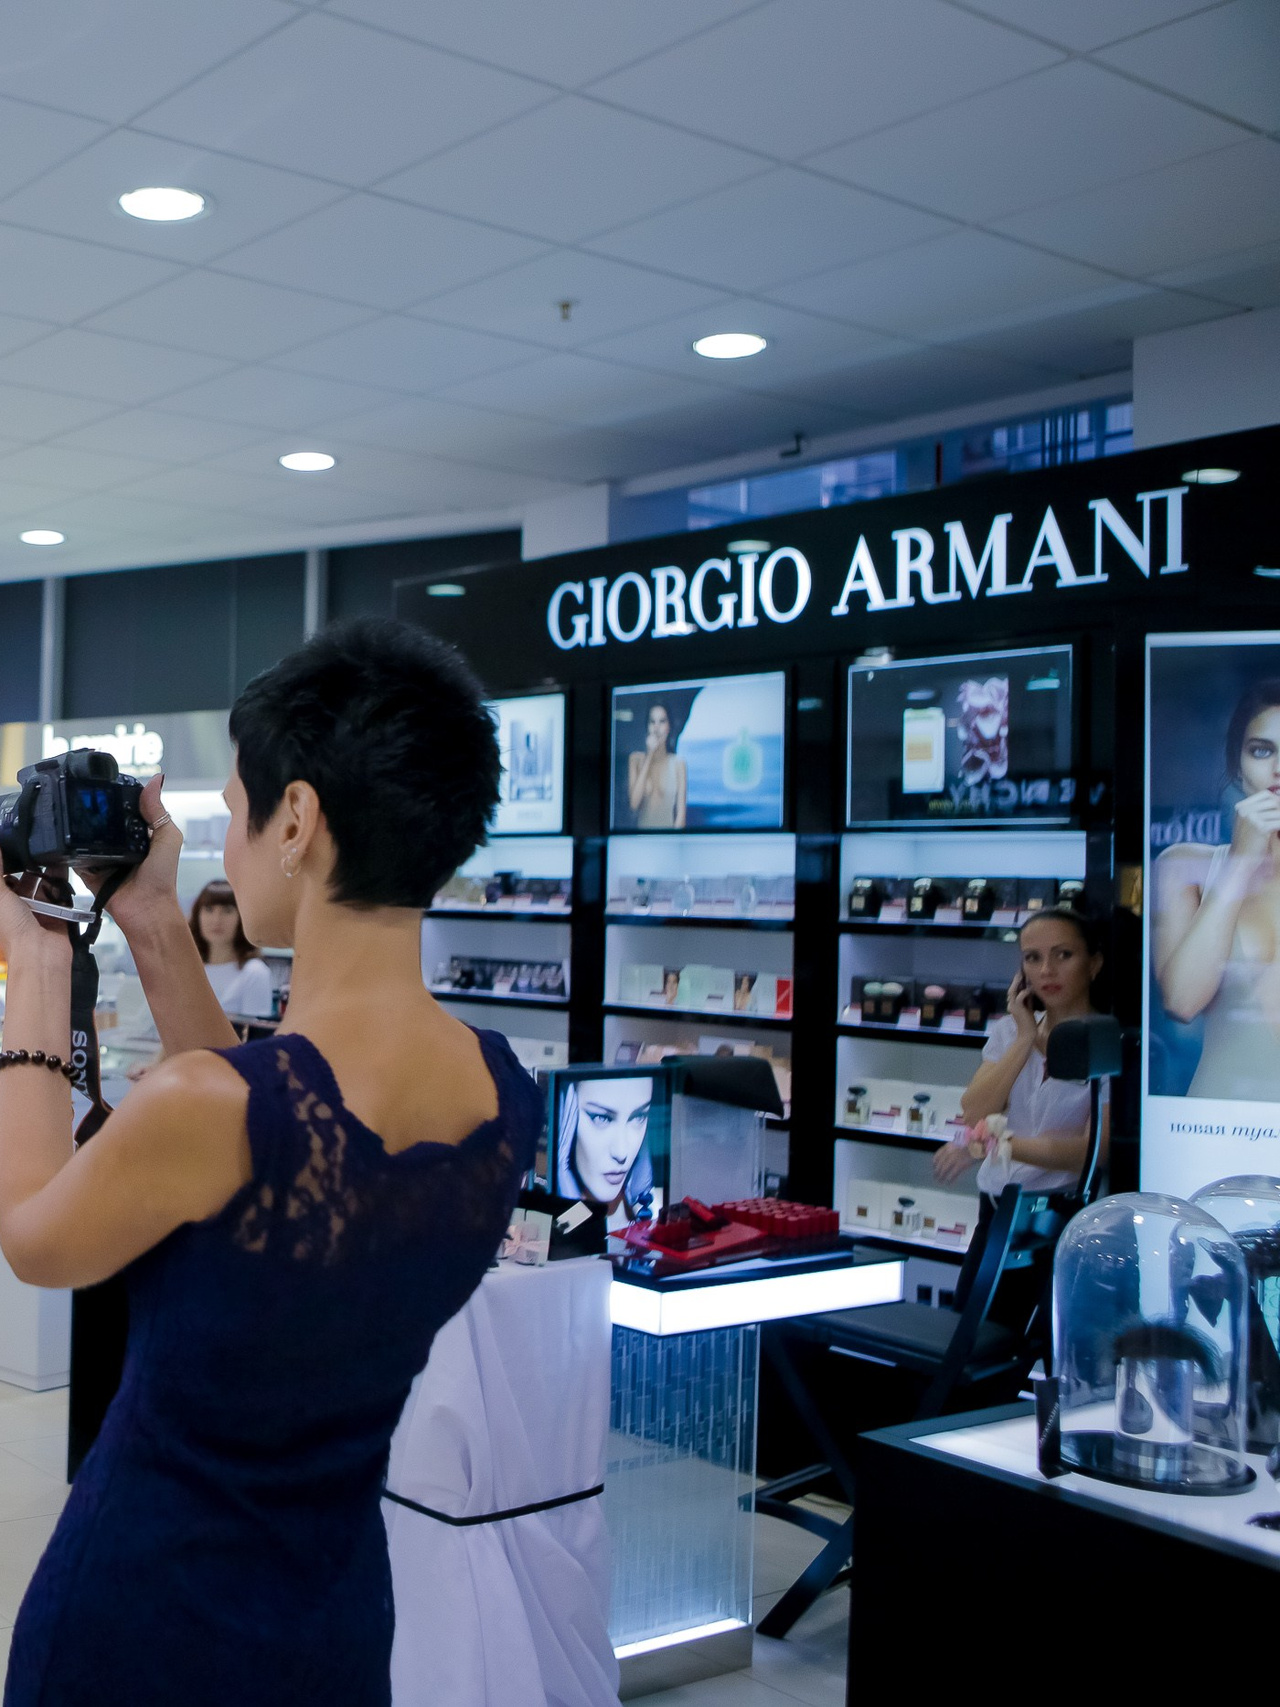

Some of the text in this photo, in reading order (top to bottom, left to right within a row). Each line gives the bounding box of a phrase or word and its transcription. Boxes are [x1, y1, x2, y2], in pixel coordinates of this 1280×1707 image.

[547, 485, 1190, 650] GIORGIO ARMANI
[1170, 1122, 1225, 1136] новая
